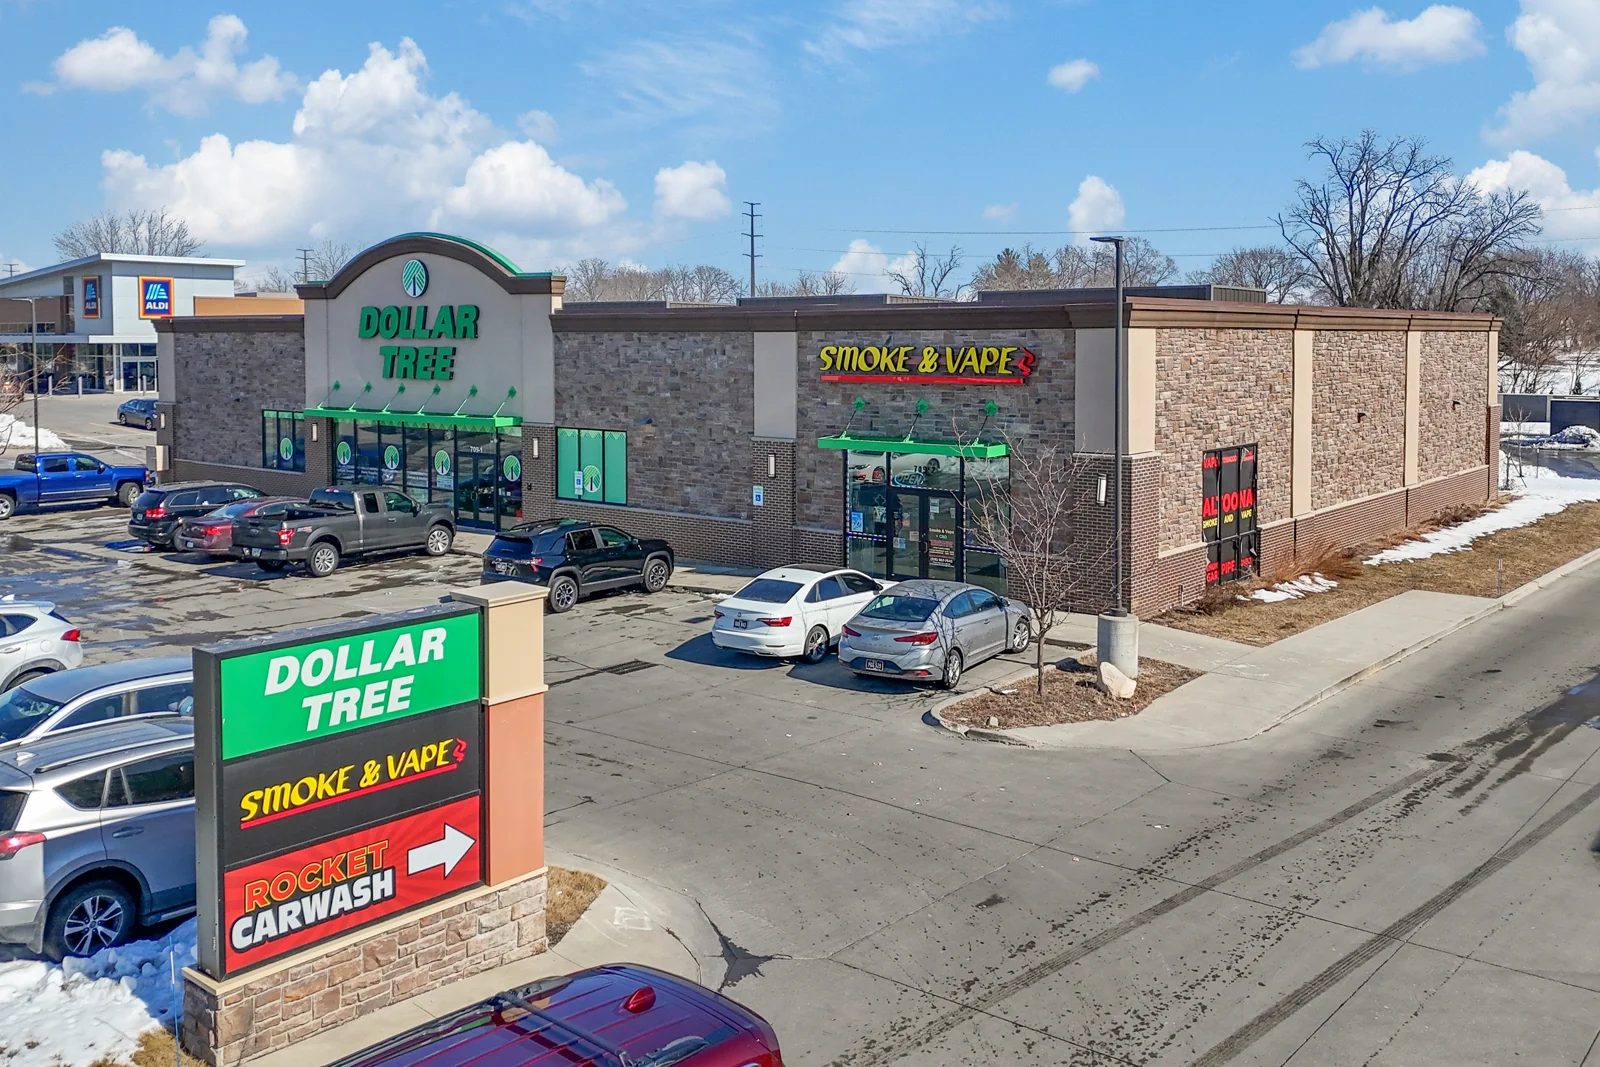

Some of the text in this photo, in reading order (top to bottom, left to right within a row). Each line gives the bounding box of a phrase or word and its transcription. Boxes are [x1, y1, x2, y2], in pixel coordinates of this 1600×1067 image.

[85, 301, 97, 310] ALDI
[145, 301, 169, 310] ALDI
[358, 304, 480, 339] DOLLAR
[379, 345, 457, 380] TREE
[819, 346, 1018, 375] SMOKE & VAPE
[469, 445, 483, 453] 709-1
[896, 472, 922, 486] OPEN
[1202, 508, 1253, 530] SMOKE AND VAPE
[1221, 559, 1237, 575] PIPE
[264, 627, 447, 696] DOLLAR
[301, 675, 415, 732] TREE
[240, 738, 454, 822] SMOKE & VAPE
[245, 840, 389, 913] ROCKET
[231, 868, 394, 950] CARWASH
